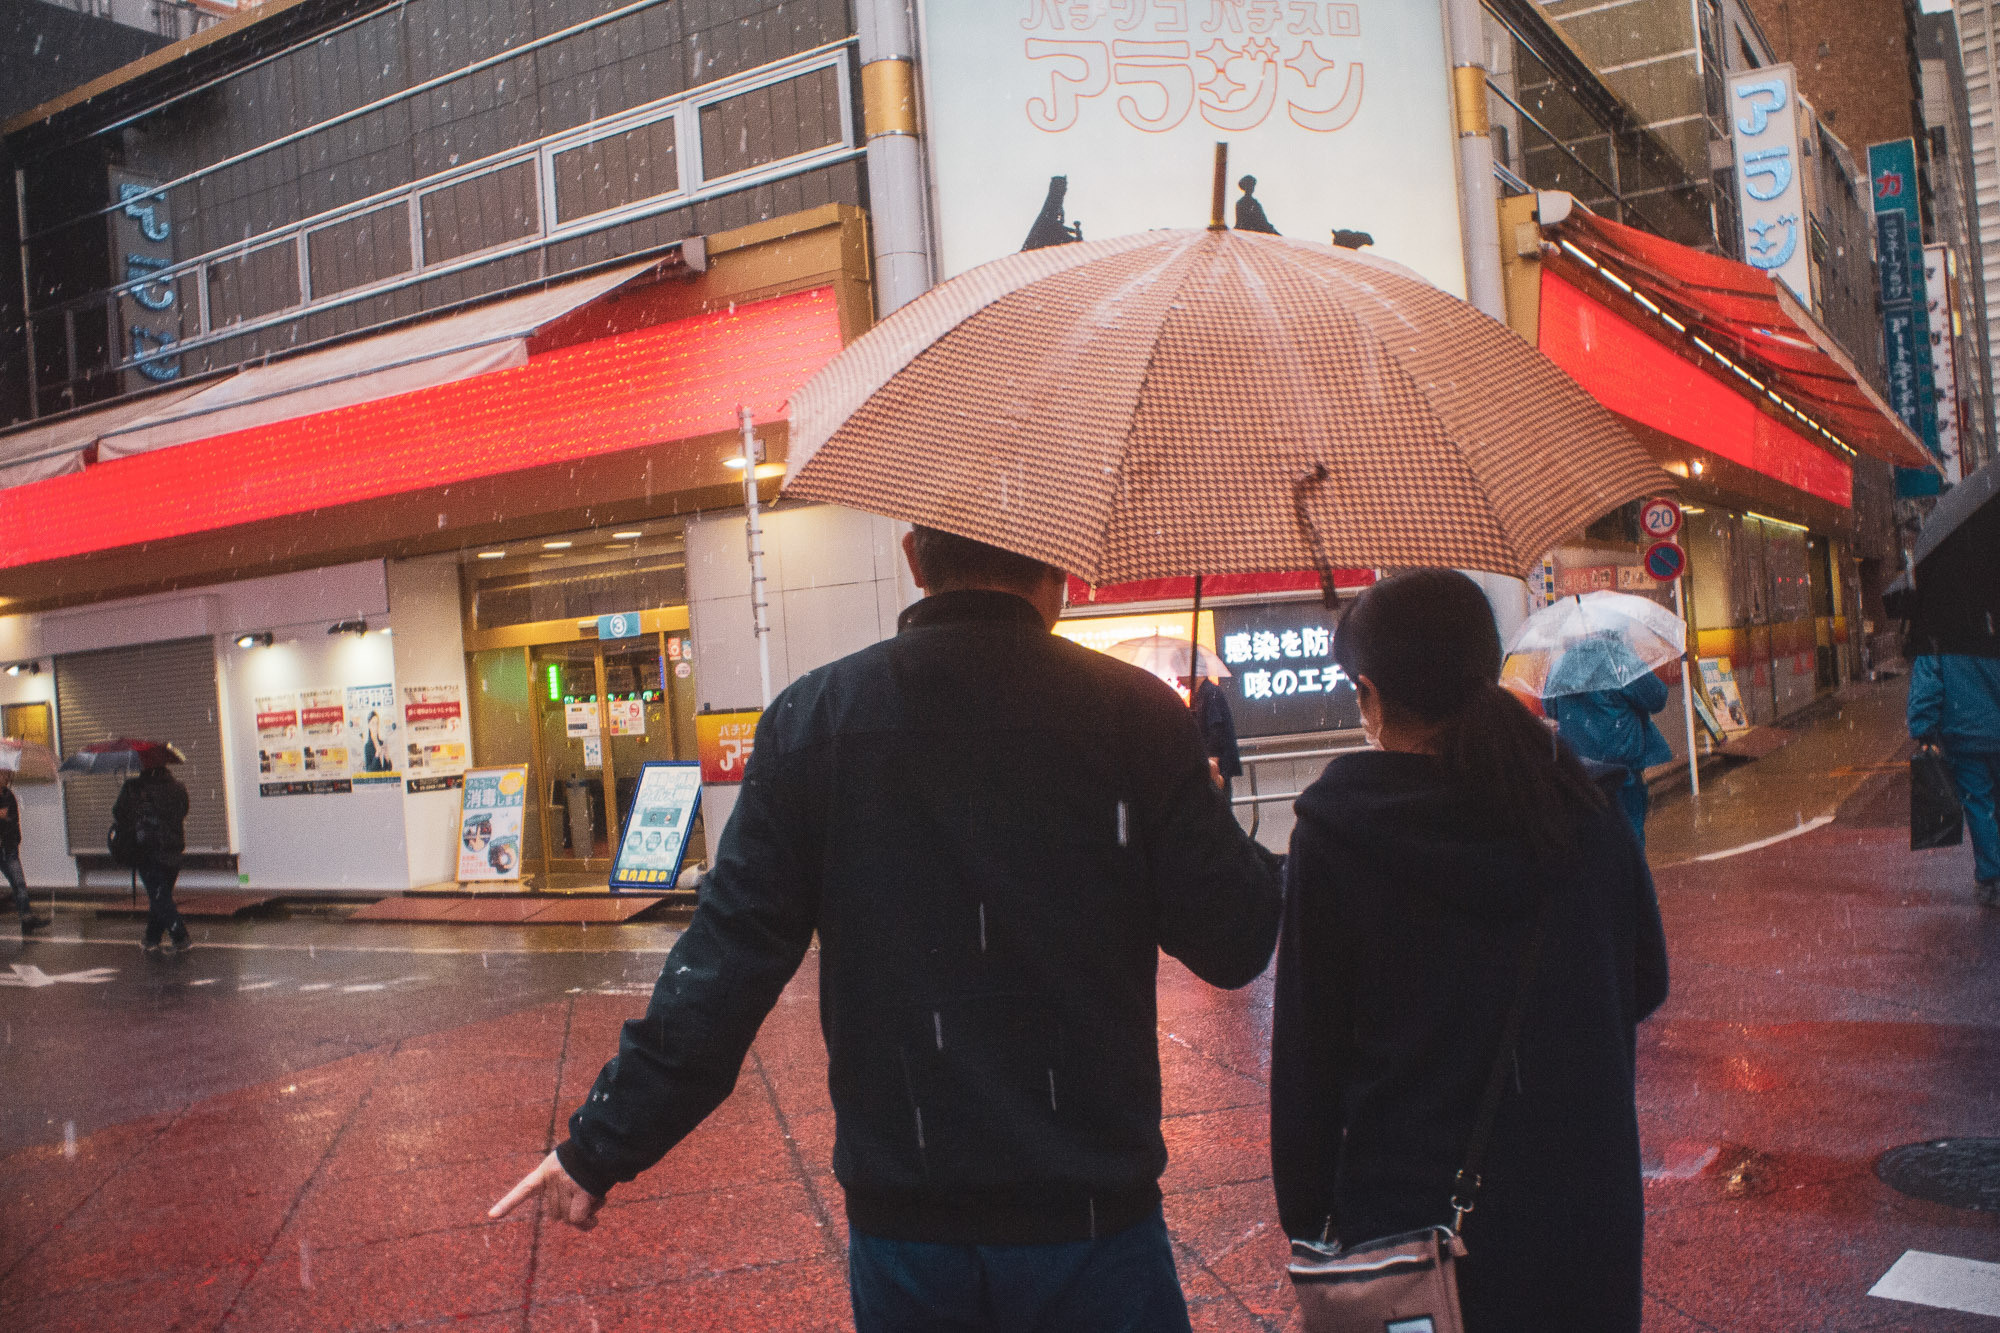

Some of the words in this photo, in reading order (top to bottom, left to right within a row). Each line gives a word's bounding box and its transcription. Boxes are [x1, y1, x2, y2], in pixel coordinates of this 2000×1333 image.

[1200, 0, 1361, 36] パチスロ
[1025, 37, 1364, 133] アラジン
[1737, 79, 1804, 304] アラジ
[1650, 509, 1673, 529] 20
[1224, 626, 1334, 664] 感染を防
[1243, 664, 1358, 700] 咳のエチ
